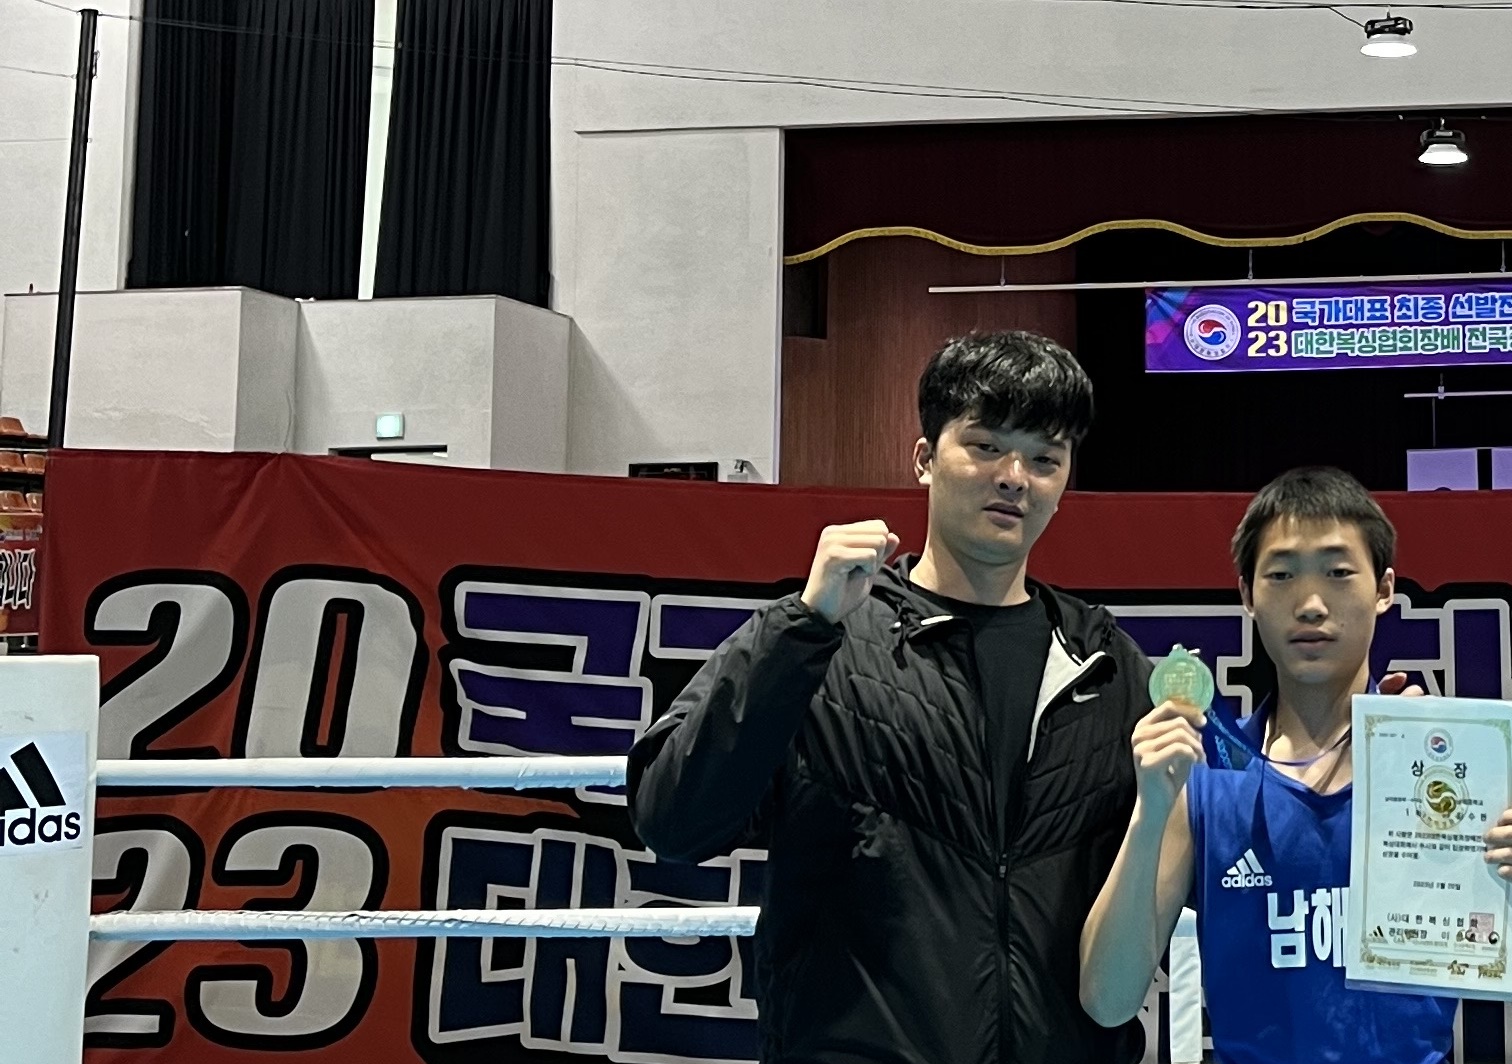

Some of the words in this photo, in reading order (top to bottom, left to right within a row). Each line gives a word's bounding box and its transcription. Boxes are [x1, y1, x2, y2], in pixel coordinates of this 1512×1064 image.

[1247, 300, 1288, 327] 20
[1292, 297, 1390, 325] 국가대표
[1394, 294, 1445, 322] 최종
[1247, 331, 1288, 357] 23
[1291, 325, 1463, 358] 대한복싱협회장배
[91, 578, 420, 768] 20
[1410, 759, 1425, 778] 상
[1453, 761, 1468, 780] 장
[0, 807, 81, 848] idas
[1221, 872, 1273, 888] adidas
[87, 823, 378, 1038] 23
[1266, 886, 1350, 969] 남해
